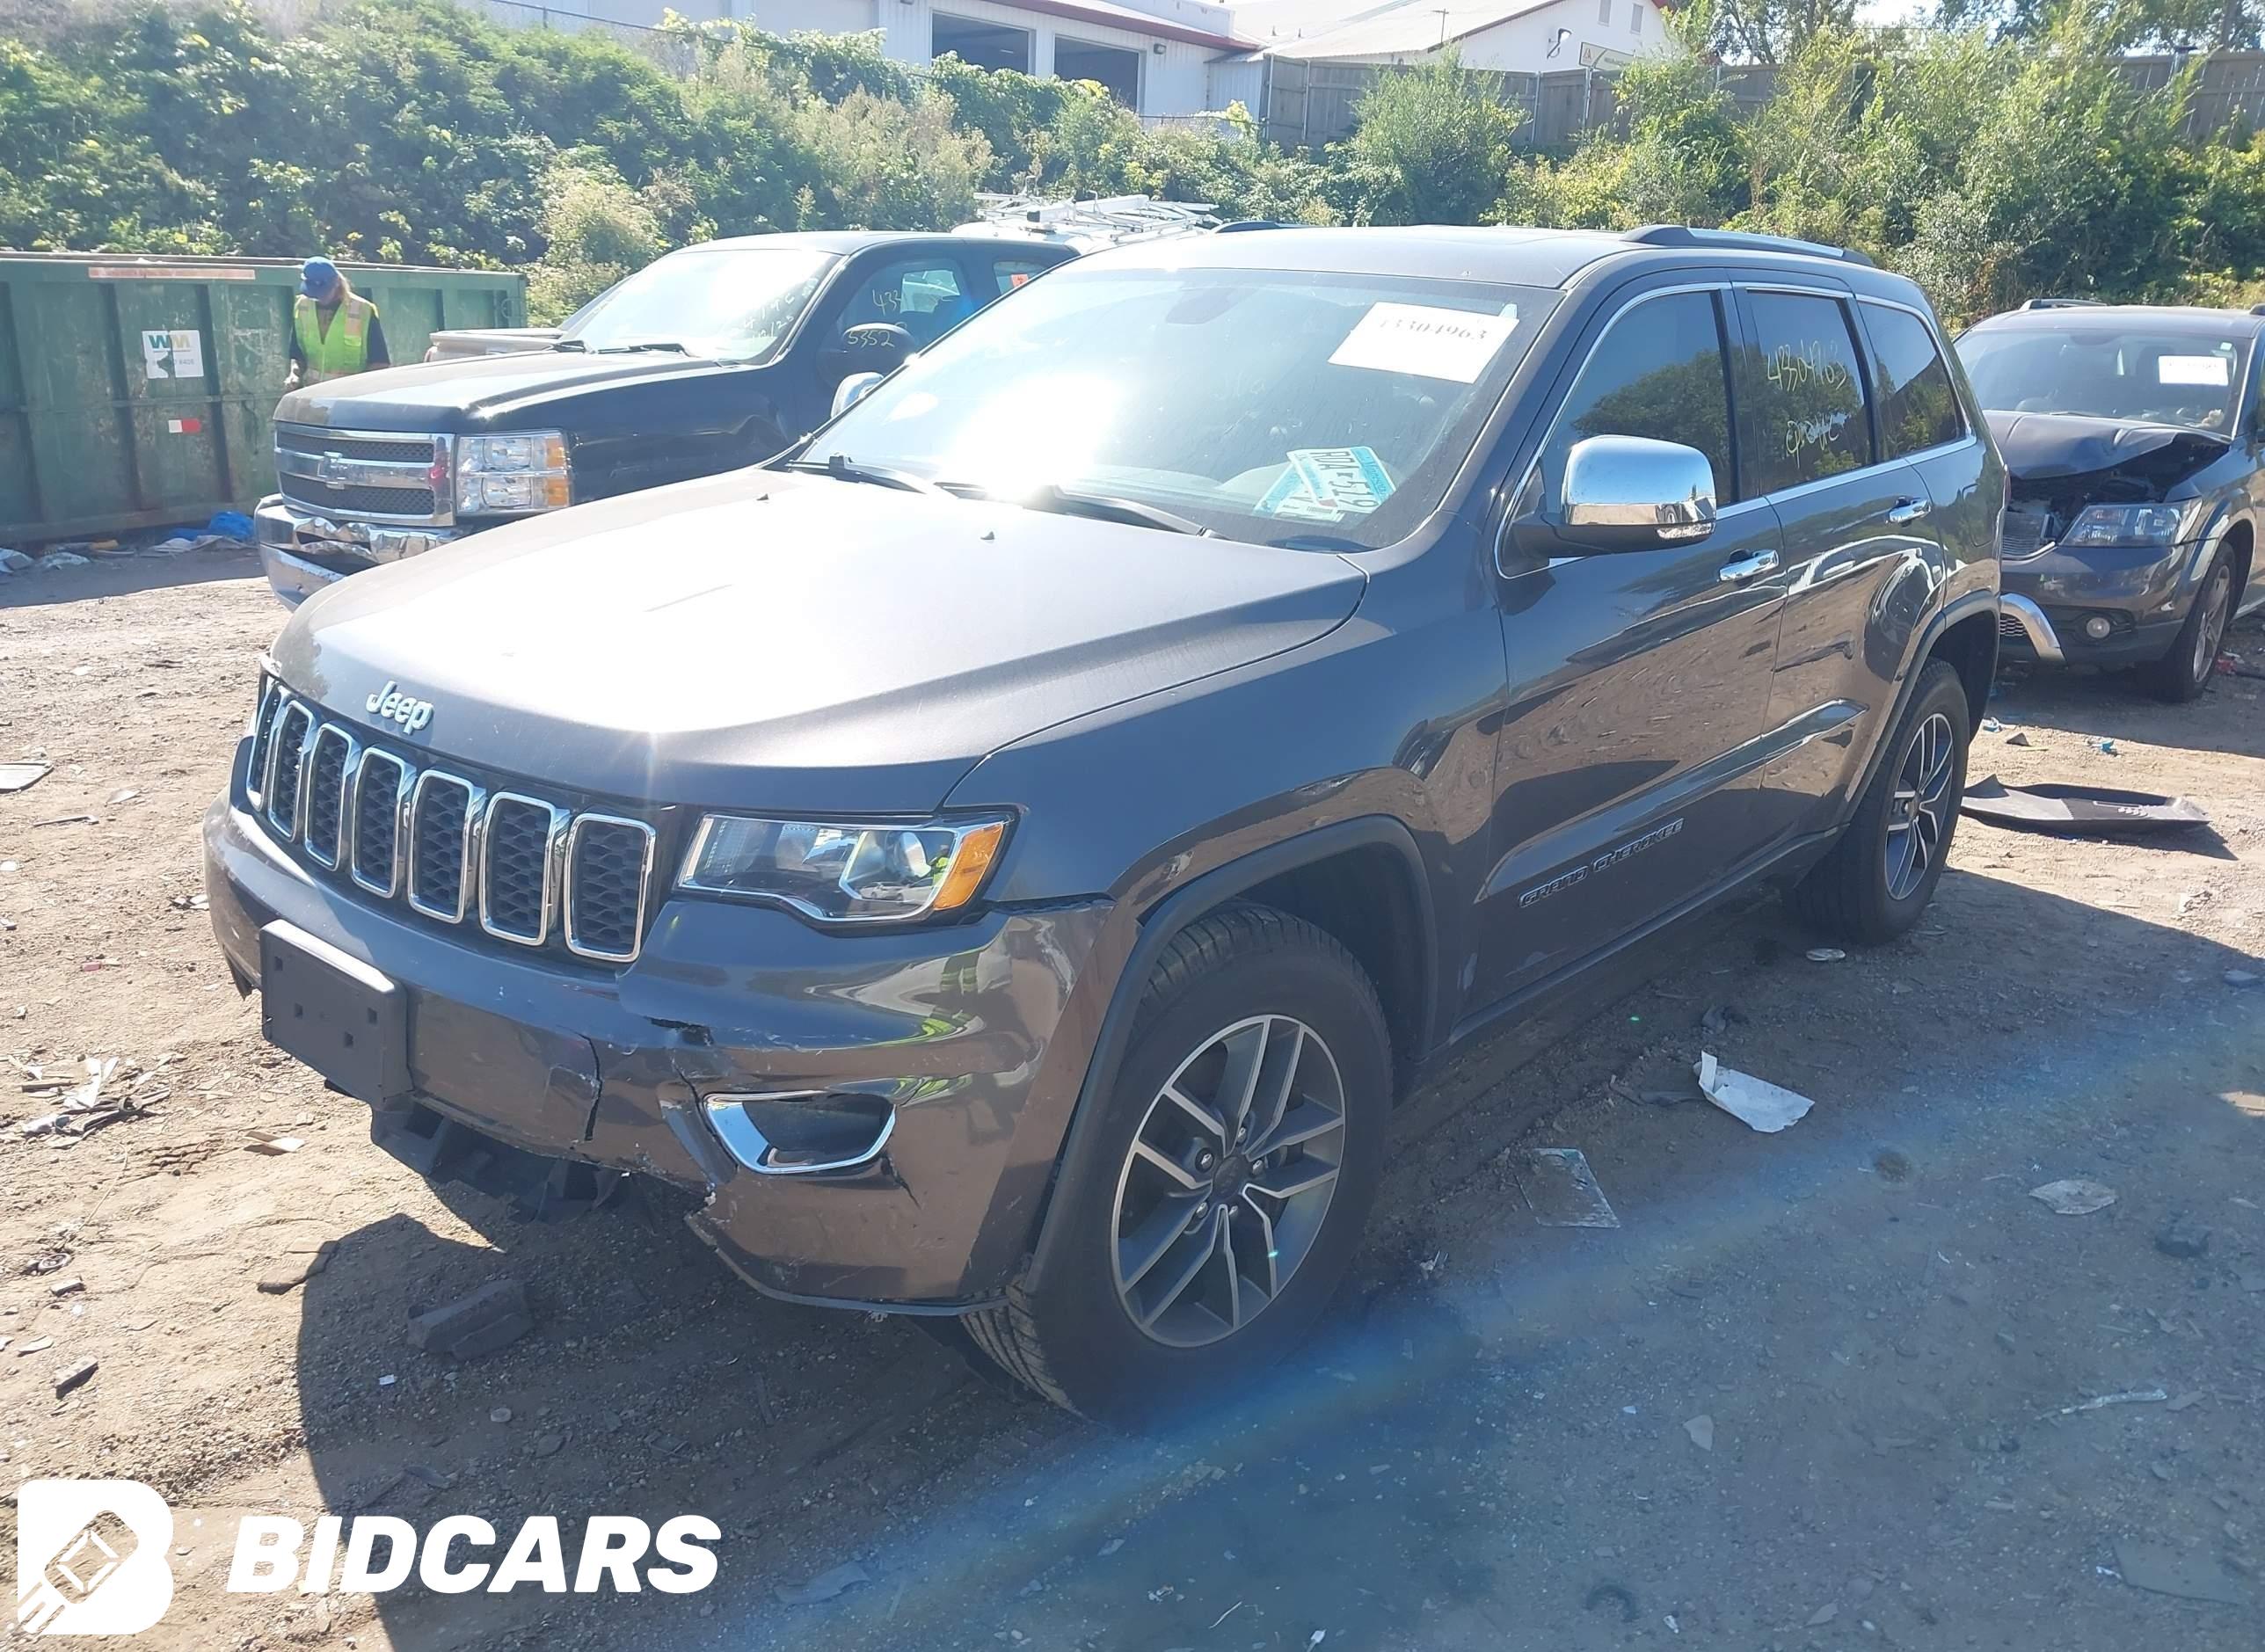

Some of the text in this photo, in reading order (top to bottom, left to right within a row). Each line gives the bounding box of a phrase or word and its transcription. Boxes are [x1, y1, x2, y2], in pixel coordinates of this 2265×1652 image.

[148, 334, 191, 349] WM
[366, 680, 434, 735] Jeep
[1519, 818, 1684, 907] GRAND CHEROKEE
